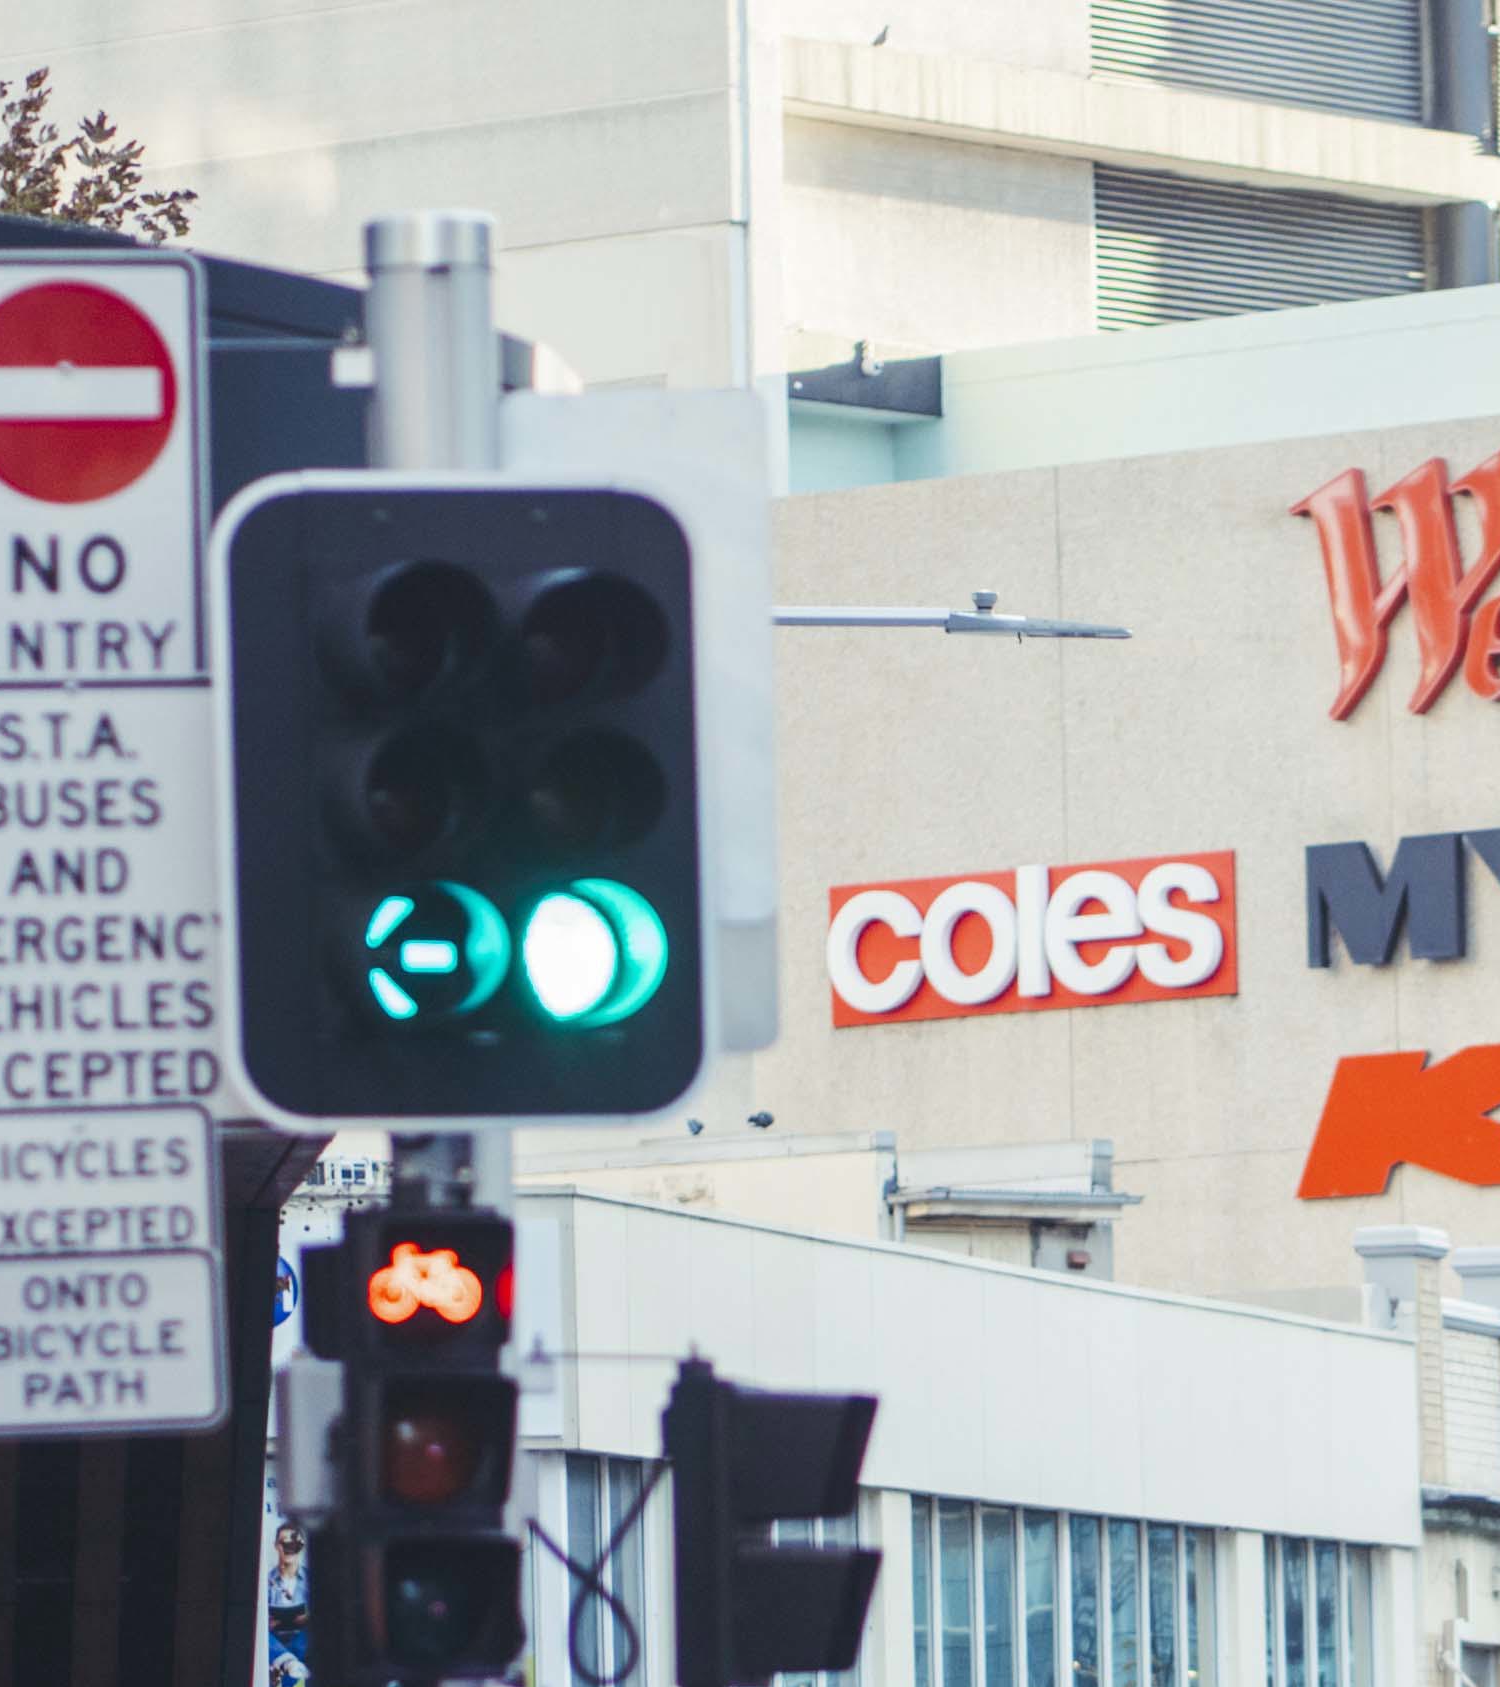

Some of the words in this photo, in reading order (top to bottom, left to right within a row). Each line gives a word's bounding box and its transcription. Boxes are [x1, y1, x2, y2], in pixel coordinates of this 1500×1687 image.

[11, 535, 127, 593] NO
[8, 847, 129, 896] AND
[826, 862, 1224, 1014] coles
[22, 1272, 148, 1313] ONTO
[22, 1372, 146, 1408] PATH
